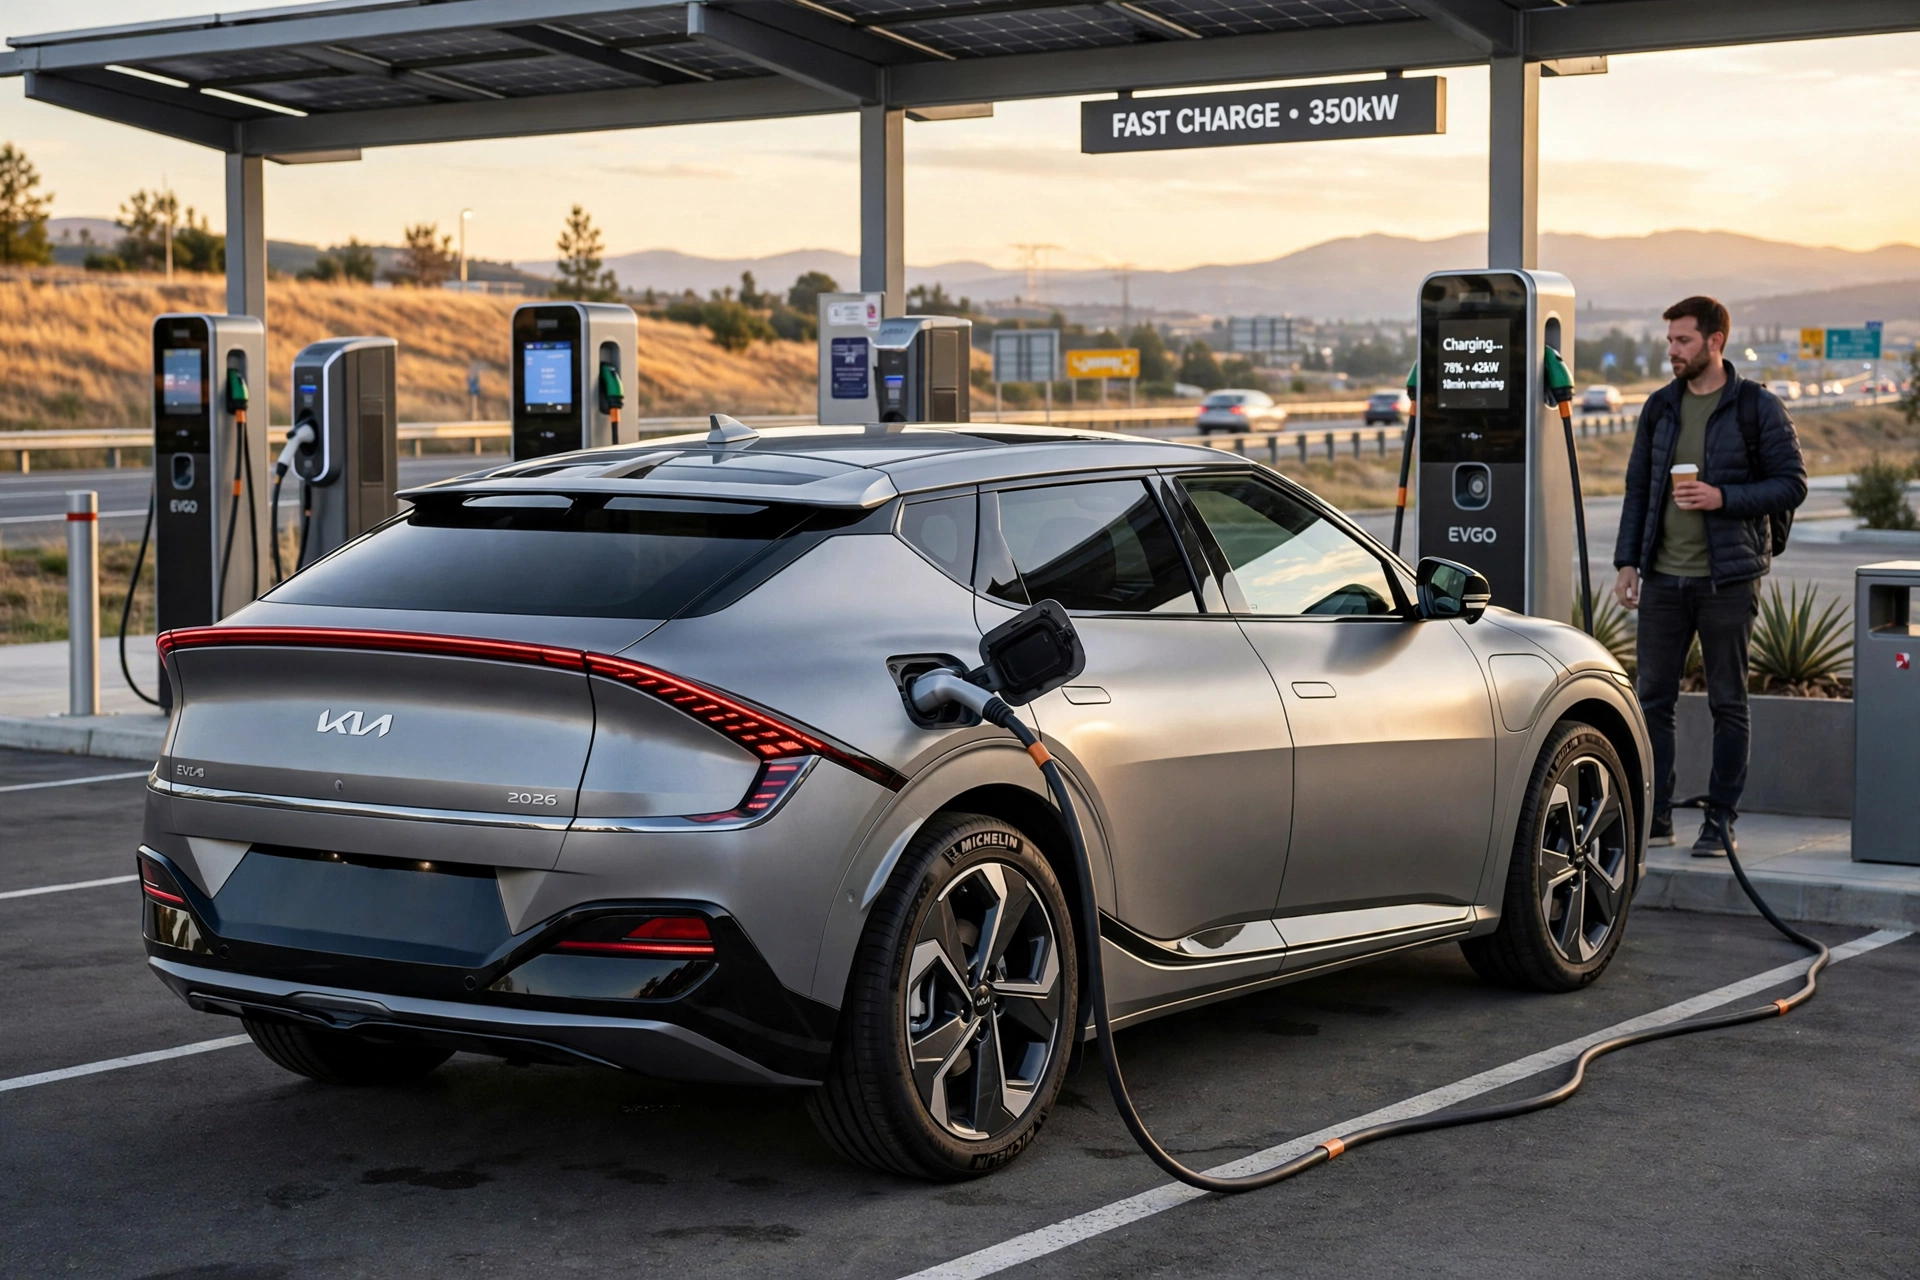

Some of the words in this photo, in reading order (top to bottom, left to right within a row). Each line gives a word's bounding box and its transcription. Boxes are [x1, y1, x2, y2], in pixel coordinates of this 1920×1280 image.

[1112, 109, 1171, 138] FAST
[1176, 102, 1280, 133] CHARGE
[1308, 93, 1399, 125] 350kW
[1442, 336, 1504, 354] Charging...
[169, 499, 198, 514] EVGO
[1448, 526, 1497, 544] EVGO
[316, 708, 394, 738] KIA
[507, 791, 558, 807] 2026
[961, 832, 1018, 854] MICHELIN
